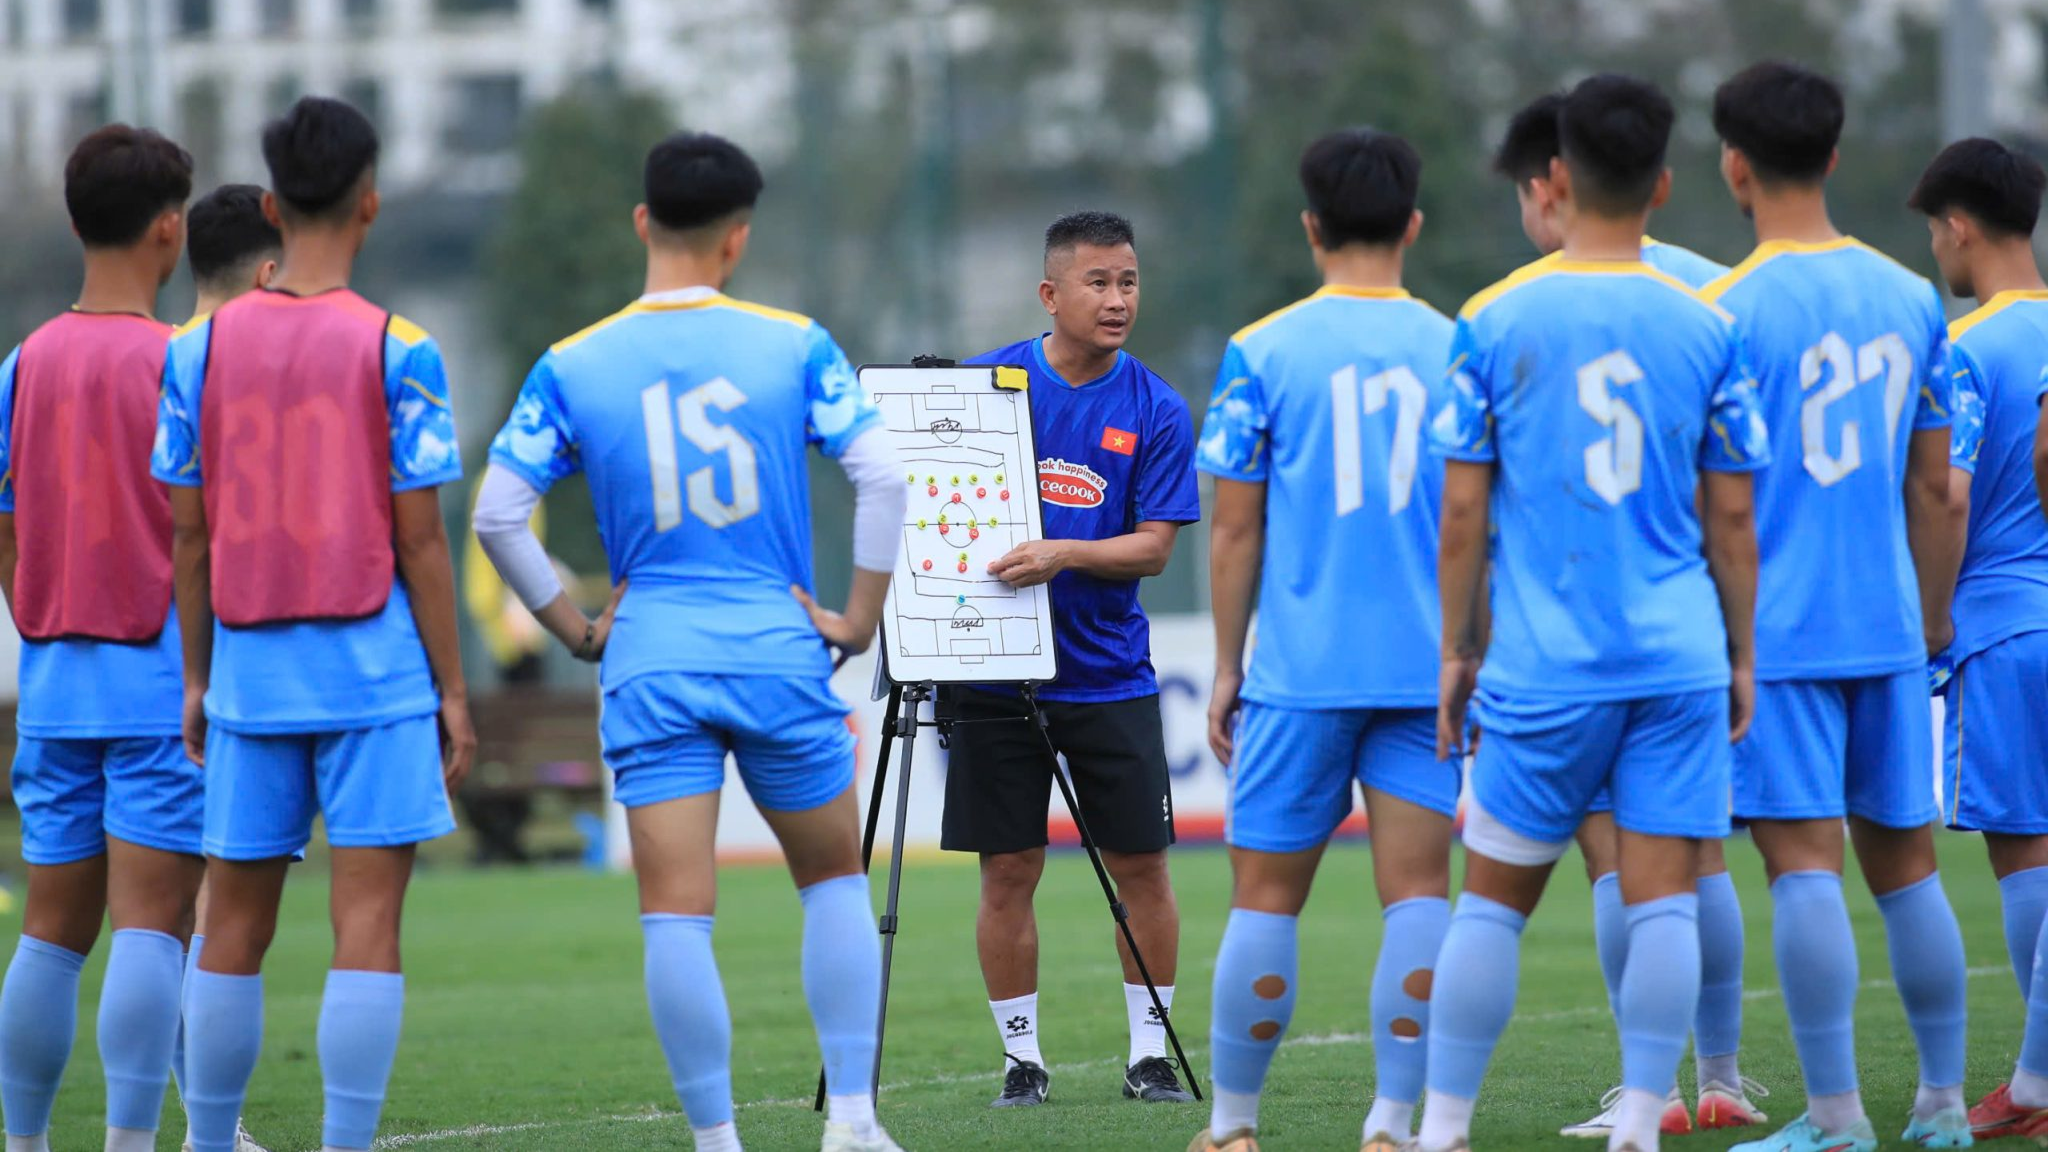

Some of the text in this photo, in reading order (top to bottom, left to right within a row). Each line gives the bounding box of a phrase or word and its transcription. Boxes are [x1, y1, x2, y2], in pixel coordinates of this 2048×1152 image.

[219, 393, 346, 545] 30
[640, 375, 760, 534] 15
[1058, 461, 1105, 488] happiness
[1331, 363, 1427, 517] 17
[1576, 349, 1644, 506] 5
[1799, 331, 1913, 488] 27
[1040, 480, 1096, 502] cecook
